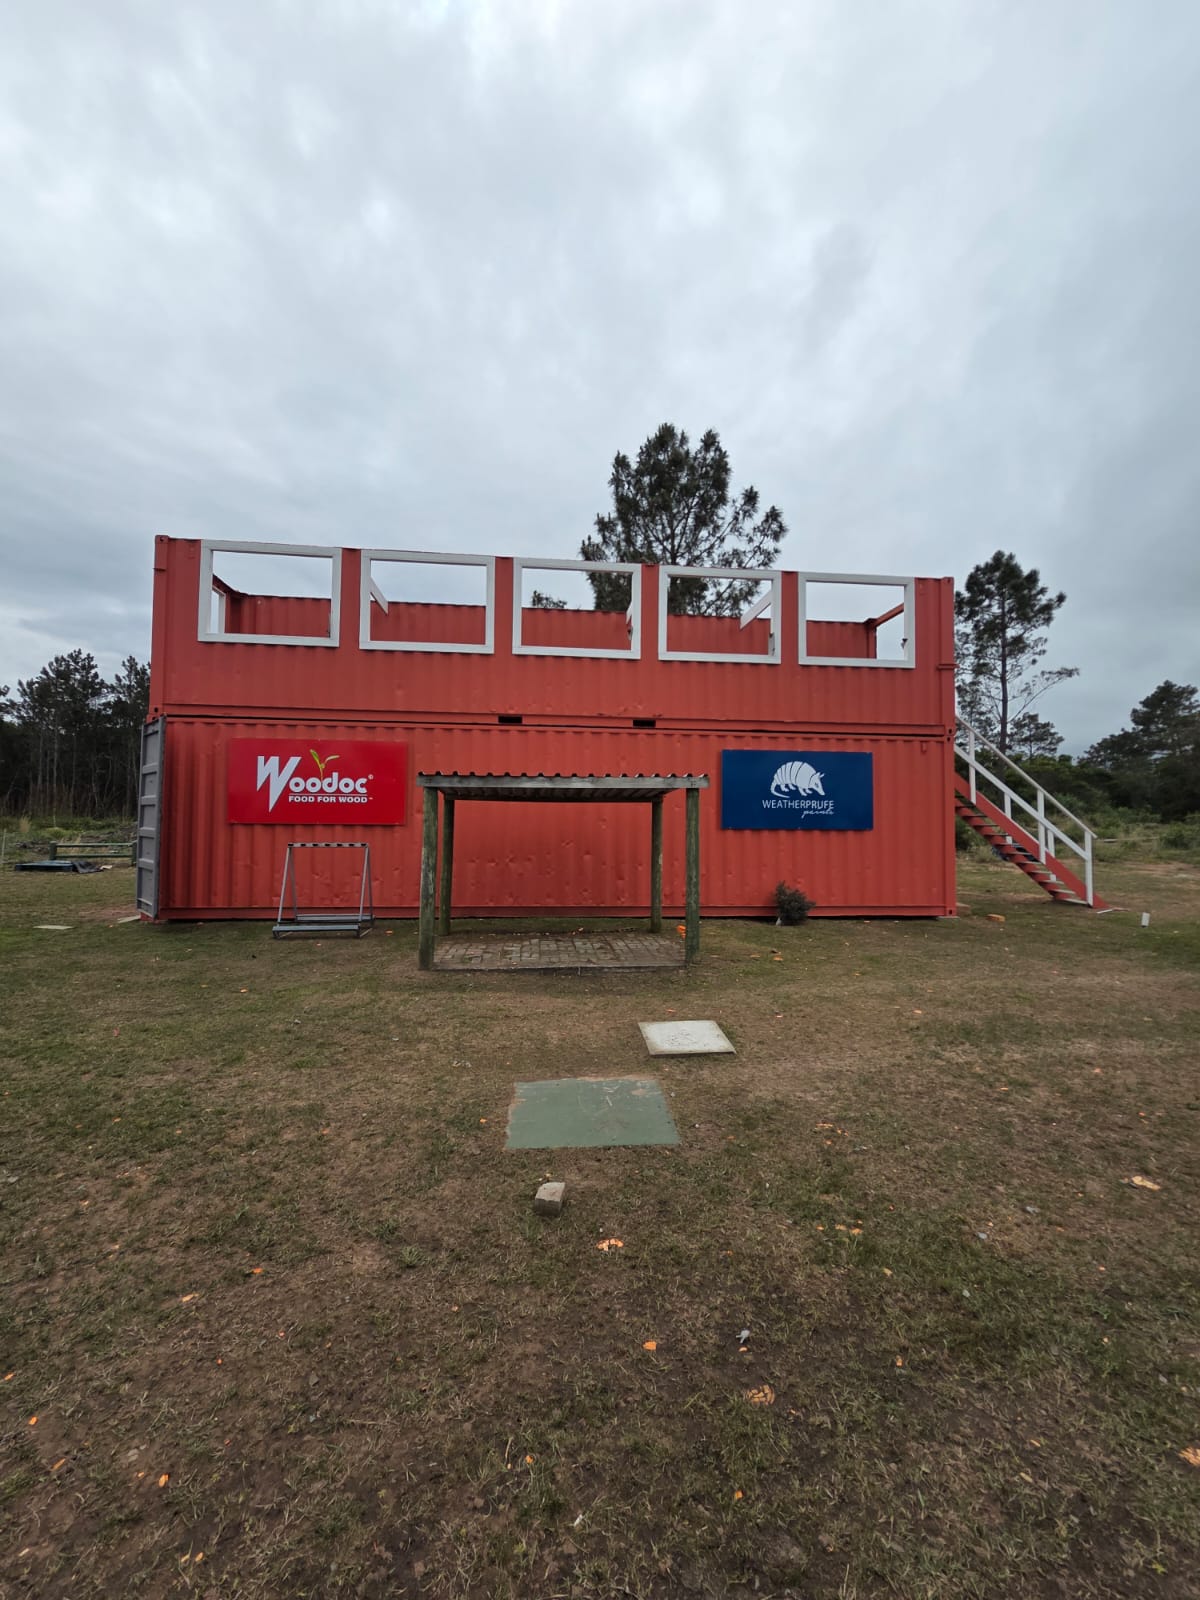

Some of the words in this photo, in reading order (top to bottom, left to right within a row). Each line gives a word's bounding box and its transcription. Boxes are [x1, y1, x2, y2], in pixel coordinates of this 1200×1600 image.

[288, 795, 315, 803] FOOD
[317, 795, 336, 803] FOR
[338, 796, 368, 804] WOOD
[762, 799, 834, 809] WEATHERPRUFE
